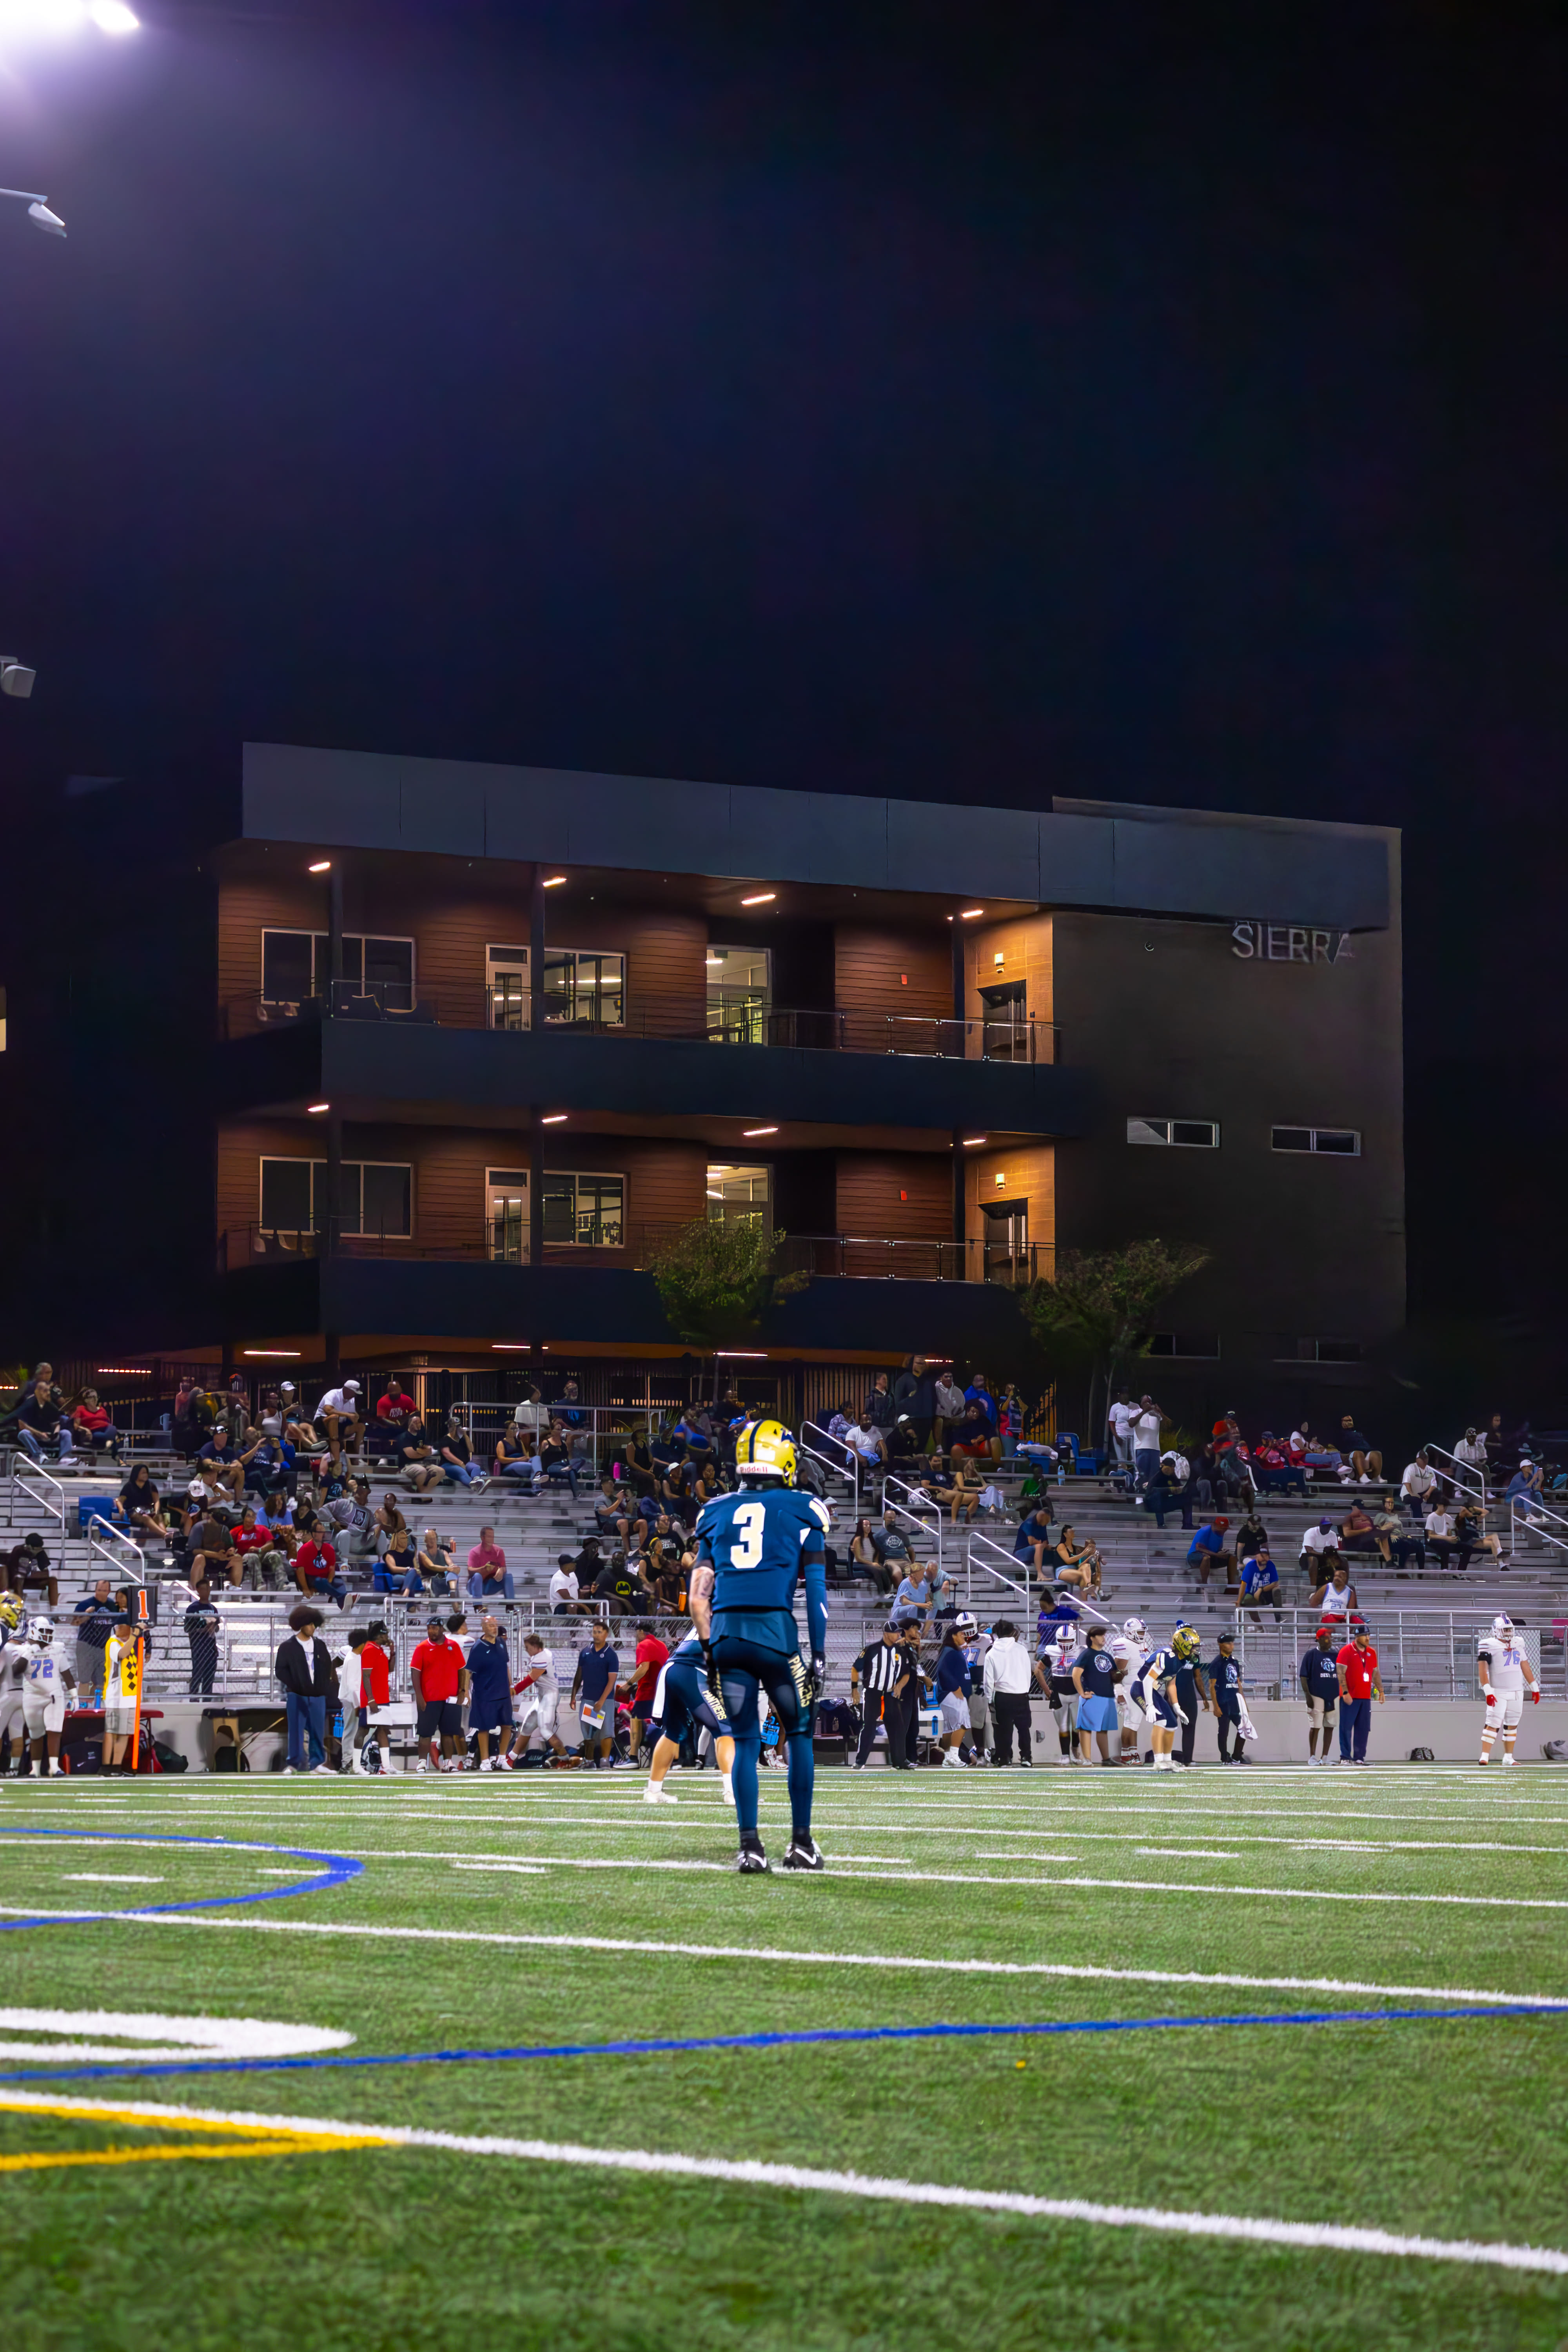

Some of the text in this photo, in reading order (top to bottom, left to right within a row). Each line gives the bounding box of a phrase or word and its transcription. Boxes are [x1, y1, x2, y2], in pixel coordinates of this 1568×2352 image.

[730, 1502, 766, 1568] 3
[138, 1589, 149, 1620] 1
[31, 1659, 53, 1679] 72
[1503, 1650, 1520, 1666] 76
[702, 1690, 726, 1720] PANTHERS
